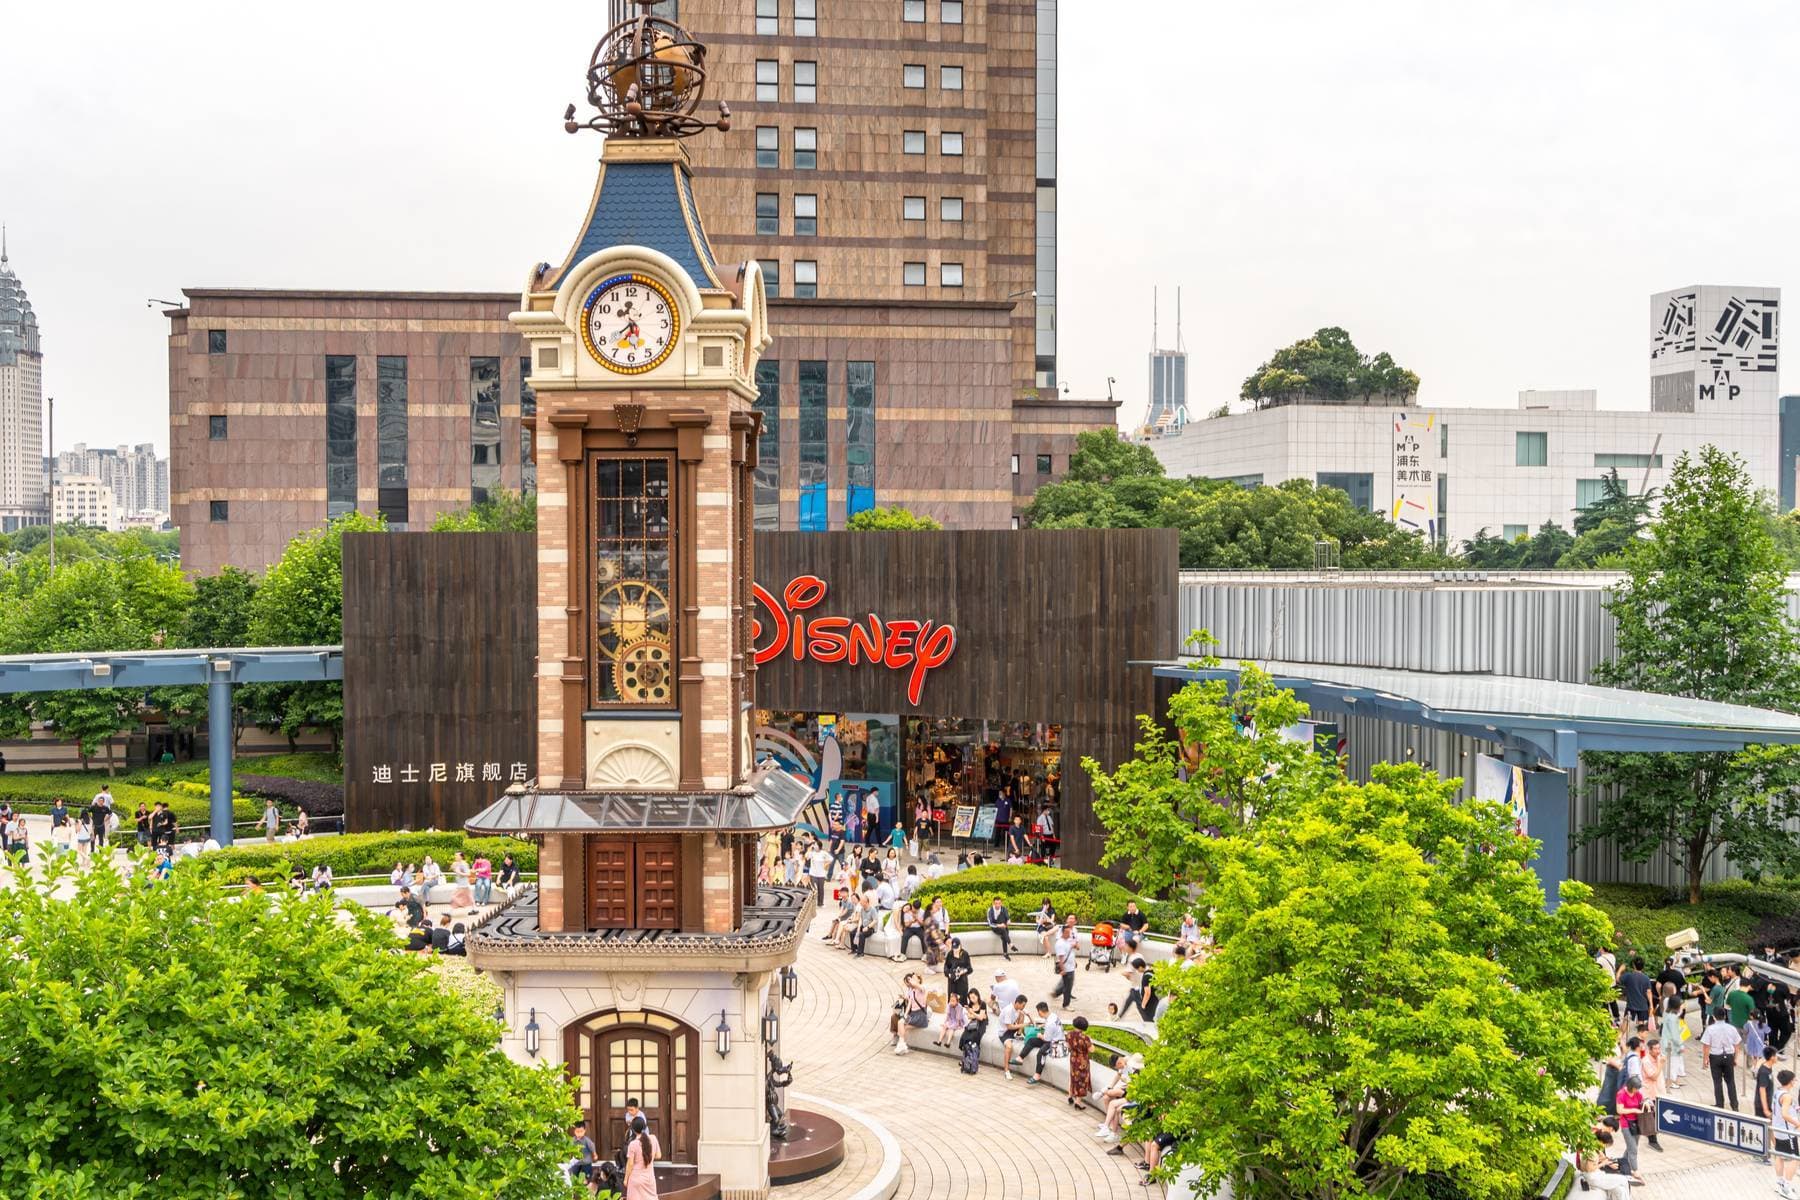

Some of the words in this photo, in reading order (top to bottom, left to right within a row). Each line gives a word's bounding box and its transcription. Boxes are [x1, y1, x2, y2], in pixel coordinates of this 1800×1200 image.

[611, 292, 619, 301] 11
[625, 288, 637, 297] 12
[645, 292, 650, 301] 1
[599, 304, 611, 314] 10
[656, 304, 664, 313] 2
[594, 321, 601, 330] 9
[661, 320, 668, 328] 3
[599, 336, 607, 346] 8
[656, 337, 664, 345] 4
[611, 348, 619, 358] 7
[628, 353, 635, 362] 6
[645, 349, 652, 358] 5
[1397, 455, 1419, 467] 浦东
[1396, 470, 1432, 482] 美术馆
[372, 762, 528, 784] 迪士尼旗舰店
